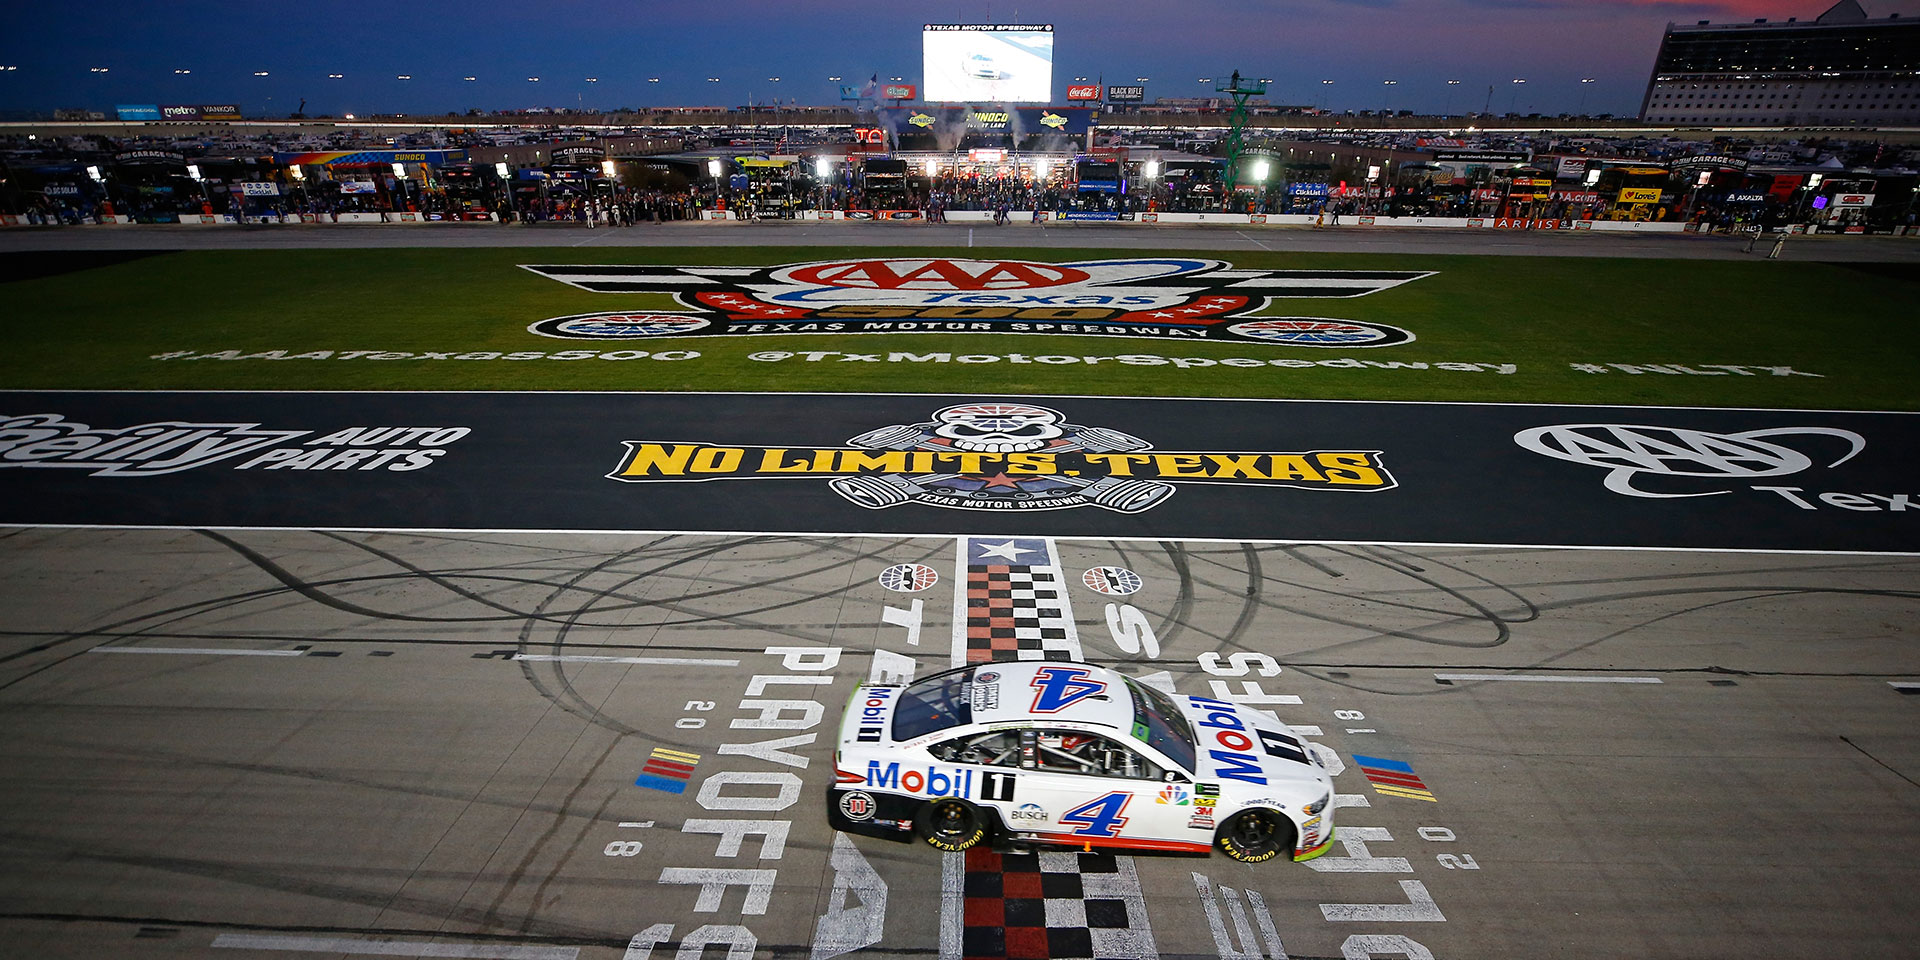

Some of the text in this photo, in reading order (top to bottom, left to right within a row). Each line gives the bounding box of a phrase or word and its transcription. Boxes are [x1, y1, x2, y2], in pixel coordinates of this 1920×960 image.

[1110, 87, 1142, 95] BLACK RIFLE
[164, 106, 197, 117] metro
[966, 112, 1009, 123] SUNOCO
[132, 150, 165, 159] GARAGE
[394, 153, 426, 161] SUNOCO
[563, 147, 593, 155] GARAGE
[1245, 148, 1270, 156] GARAGE
[1691, 156, 1729, 164] GARAGE
[1634, 193, 1656, 201] Love's
[1736, 194, 1764, 202] AXALTA
[1058, 211, 1067, 219] 24
[812, 260, 1078, 290] AAA
[919, 291, 1158, 306] Texas
[813, 304, 1115, 319] 500
[726, 322, 1210, 337] TEXAS MOTOR SPEEDWAY
[150, 349, 702, 361] #AAATexas500
[747, 350, 1517, 375] @TxMotorSpeedway
[1569, 362, 1825, 378] #NLTX
[304, 427, 472, 447] AUTO
[1525, 424, 1800, 477] AAA
[233, 448, 447, 472] PARTS
[619, 444, 745, 476] NO
[1083, 452, 1384, 486] TEXAS
[916, 492, 1089, 509] TEXAS MOTOR SPEEDWAY
[1029, 666, 1108, 714] 4
[861, 688, 892, 725] Mobil
[675, 700, 716, 729] 20
[1334, 709, 1376, 734] 18
[1189, 695, 1268, 786] Mobil
[867, 760, 973, 801] Mobil
[1011, 810, 1049, 822] BUSCH
[1058, 790, 1134, 839] 4
[1194, 806, 1213, 816] 3M
[604, 821, 655, 857] 18
[1416, 825, 1480, 870] 20
